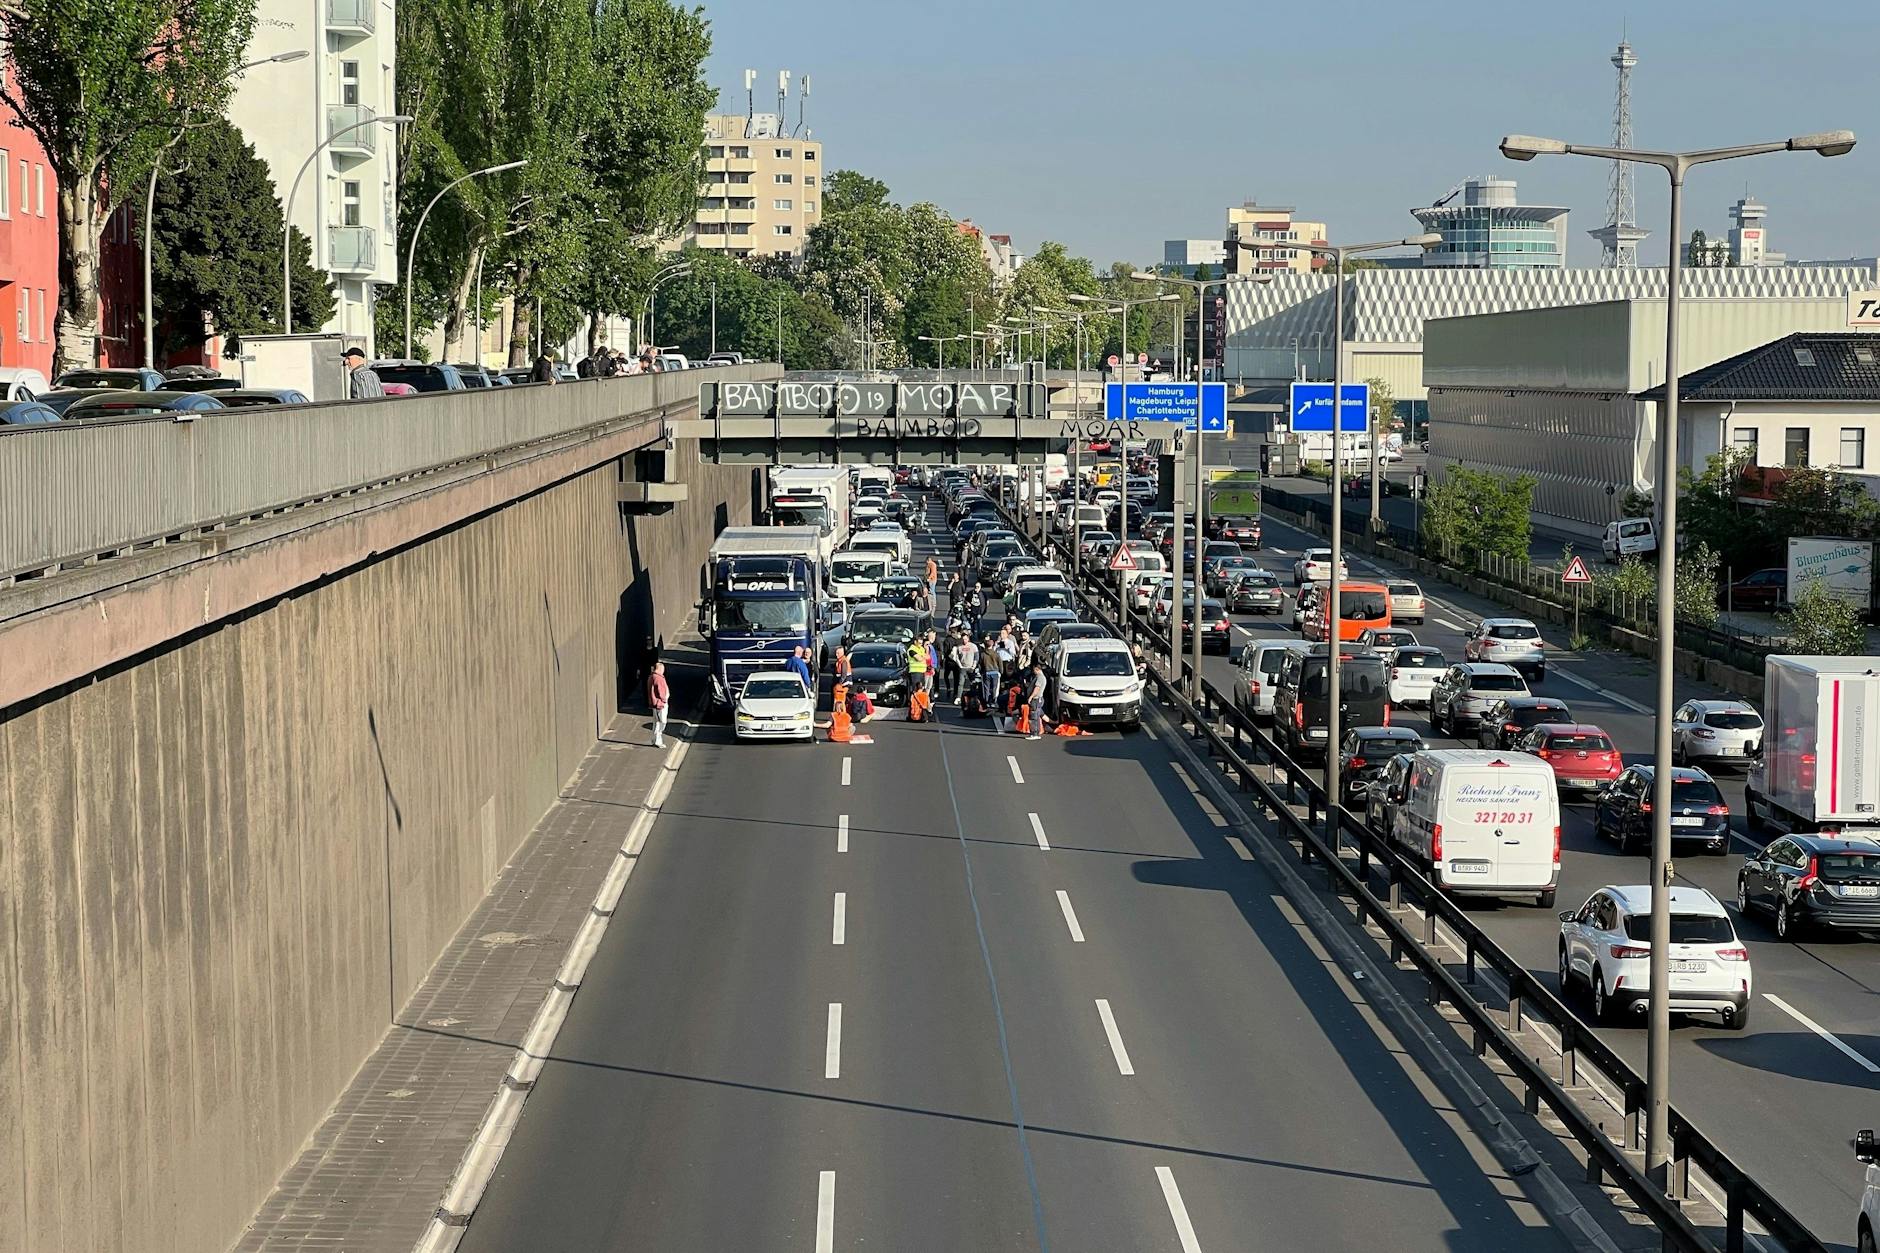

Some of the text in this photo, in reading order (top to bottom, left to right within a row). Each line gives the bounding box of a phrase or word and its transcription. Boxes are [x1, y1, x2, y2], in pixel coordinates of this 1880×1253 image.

[1148, 387, 1184, 397] Hamburg
[724, 384, 861, 414] BAMBOO
[901, 384, 1015, 414] MOAR
[1129, 397, 1173, 407] Magdeburg
[1136, 406, 1195, 416] Charlottenburg
[857, 418, 1144, 439] BAMBOO MOAR
[1796, 545, 1861, 567] Blumenhaus
[747, 581, 774, 592] OPR
[1457, 784, 1542, 800] Richard Franz
[1474, 812, 1534, 824] 321 20 31
